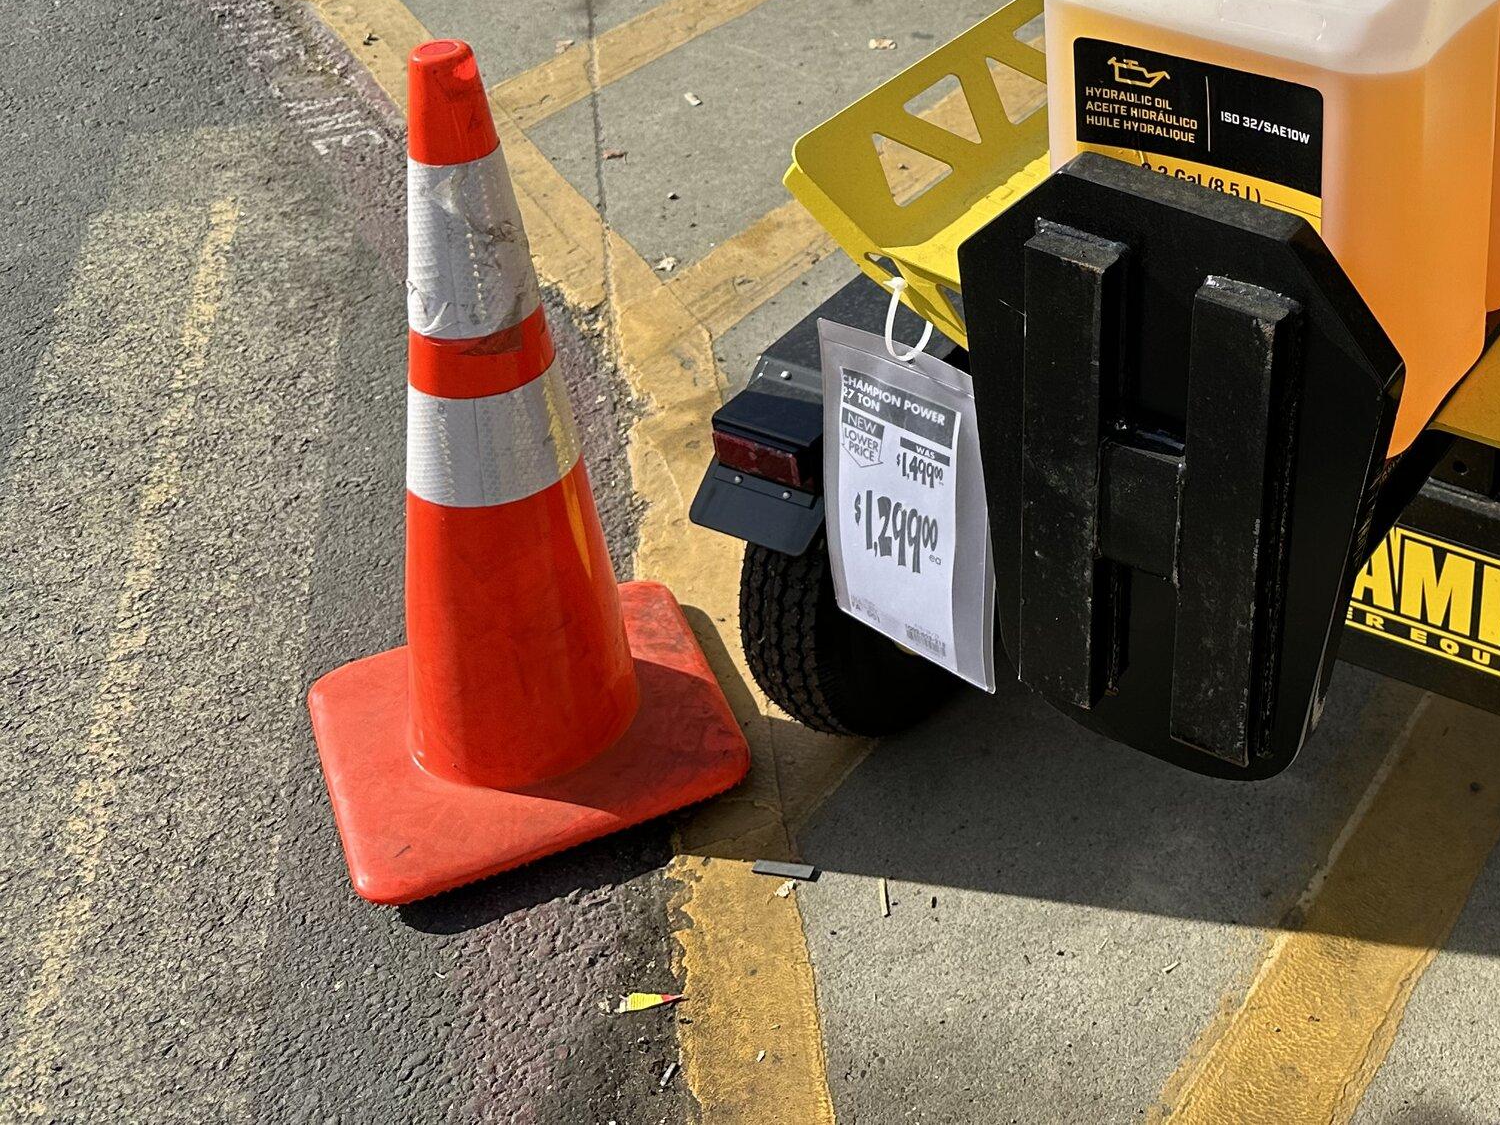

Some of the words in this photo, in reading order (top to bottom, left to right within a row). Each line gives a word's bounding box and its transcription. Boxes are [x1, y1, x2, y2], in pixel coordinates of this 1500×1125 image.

[1085, 86, 1152, 107] HYDRAULIC
[1154, 97, 1172, 111] OIL
[1085, 101, 1128, 117] ACEITE
[1130, 108, 1198, 130] HIDRÁULICO
[1086, 115, 1121, 130] HUILE
[1123, 121, 1196, 144] HYDRALIQUE
[1220, 111, 1240, 125] ISO
[1242, 115, 1311, 145] 32/SAE10W
[841, 372, 902, 411] CHAMPION
[903, 396, 946, 427] POWER
[841, 385, 855, 401] 27
[856, 392, 881, 414] TON
[847, 413, 877, 435] NEW
[844, 426, 880, 454] LOWER
[848, 439, 875, 464] PRICE
[914, 443, 936, 460] WAS
[928, 553, 942, 567] ea
